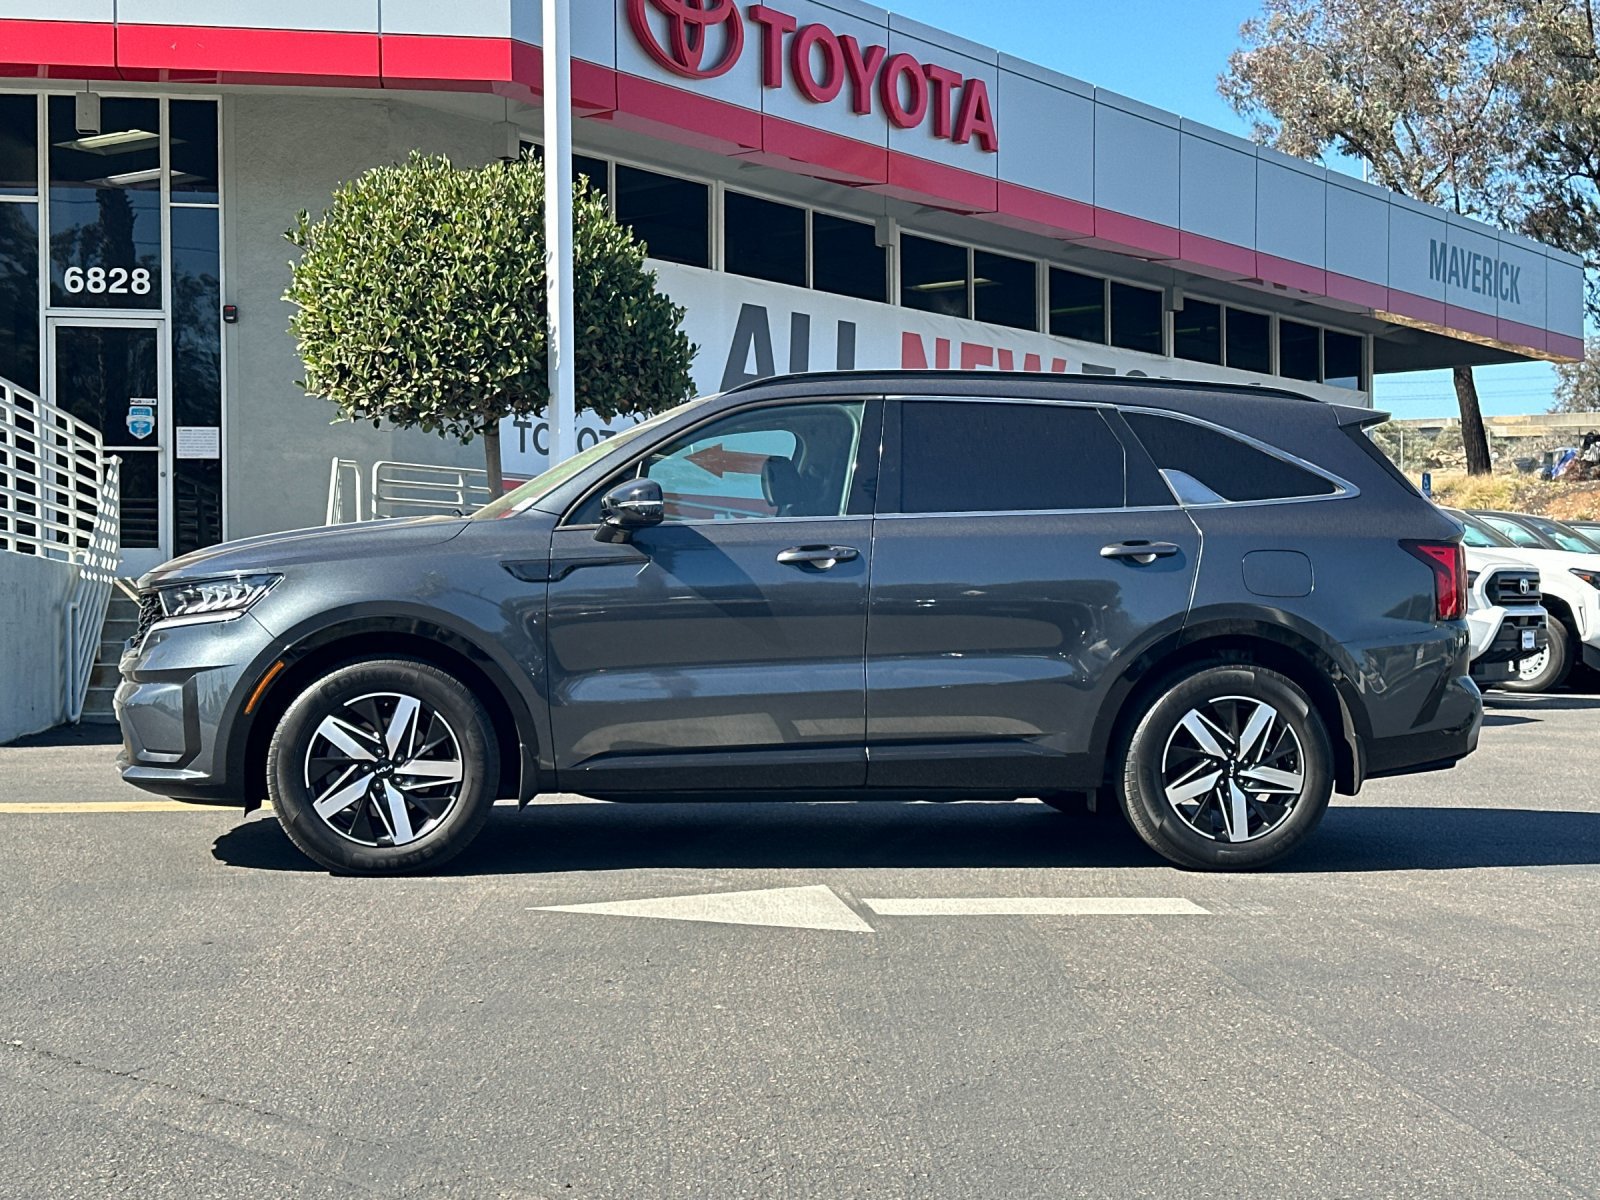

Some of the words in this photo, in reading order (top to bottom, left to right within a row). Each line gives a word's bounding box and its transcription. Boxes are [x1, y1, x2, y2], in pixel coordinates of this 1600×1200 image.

[749, 4, 998, 152] TOYOTA
[64, 266, 150, 294] 6828
[1429, 238, 1520, 304] MAVERICK
